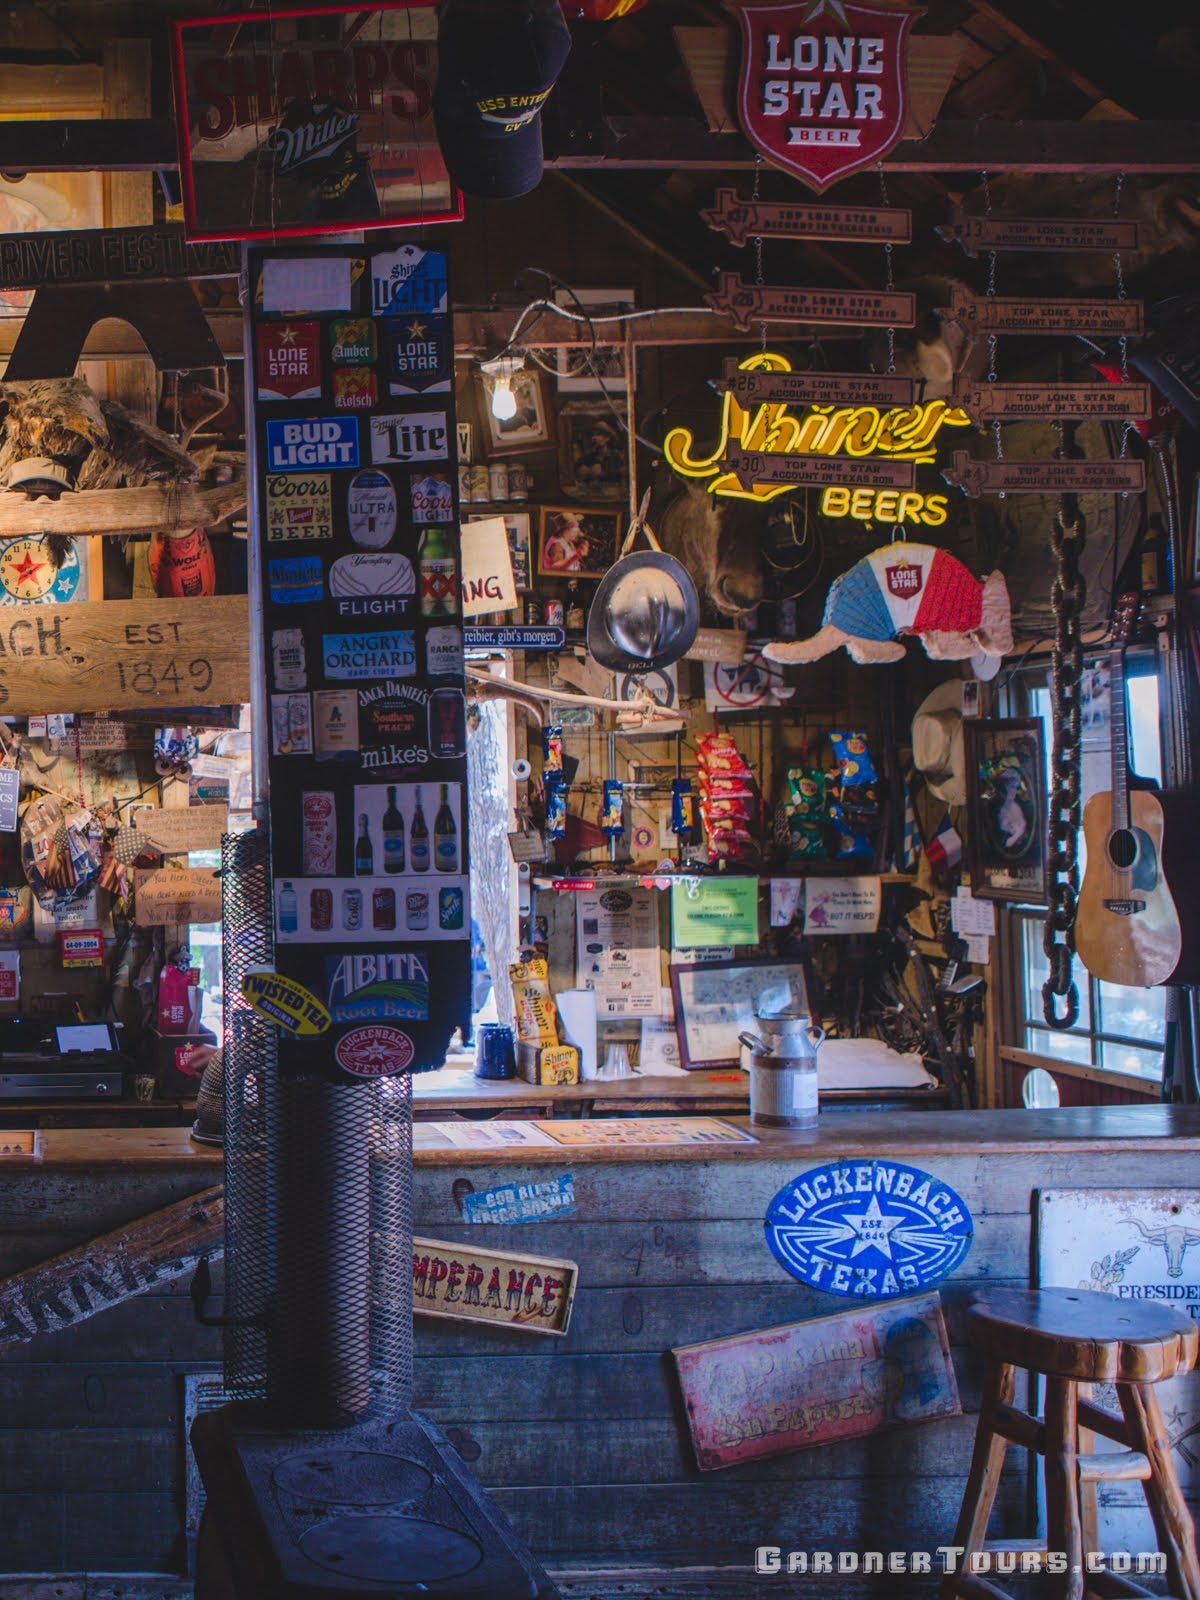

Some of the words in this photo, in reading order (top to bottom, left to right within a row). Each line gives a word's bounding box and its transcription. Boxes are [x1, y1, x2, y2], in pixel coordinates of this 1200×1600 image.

[766, 34, 884, 74] LONE
[476, 97, 506, 113] USS
[763, 80, 884, 120] STAR
[267, 111, 361, 174] Miller
[800, 130, 850, 142] BEER
[779, 211, 803, 219] TOP
[102, 232, 241, 276] FESTIVAL
[373, 278, 447, 316] LIGHT
[784, 295, 807, 304] TOP
[269, 348, 308, 362] LONE
[335, 344, 370, 358] Amber
[398, 342, 437, 355] LONE
[269, 363, 308, 376] STAR
[398, 357, 438, 371] STAR
[727, 376, 756, 392] #26
[783, 380, 807, 388] TOP
[812, 380, 841, 389] LONE
[848, 382, 879, 391] STAR
[769, 389, 818, 398] ACCOUNT
[835, 391, 869, 400] TEXAS
[963, 392, 981, 407] #3
[1017, 394, 1039, 402] TOP
[1048, 394, 1076, 402] LONE
[1084, 394, 1115, 402] STAR
[1004, 404, 1051, 412] ACCOUNT
[1069, 404, 1103, 412] TEXAS
[283, 422, 342, 445] BUD
[386, 424, 445, 460] Lite
[273, 442, 354, 466] LIGHT
[731, 456, 759, 472] #30
[785, 461, 808, 469] TOP
[814, 462, 842, 471] LONE
[851, 464, 880, 473] STAR
[1017, 467, 1040, 475] TOP
[772, 470, 820, 480] ACCOUNT
[837, 473, 870, 483] TEXAS
[964, 467, 983, 480] #4
[268, 475, 329, 497] Coors
[349, 502, 395, 514] ULTRA
[412, 493, 453, 509] Coors
[821, 487, 949, 526] BEERS
[414, 510, 449, 521] LIGHT
[271, 525, 331, 539] BEER
[172, 550, 201, 566] WOLF
[352, 555, 392, 568] Yuengling
[890, 570, 919, 581] LONE
[890, 580, 920, 591] STAR
[339, 599, 408, 615] FLIGHT
[124, 621, 183, 645] EST
[464, 629, 496, 644] reibier,
[498, 629, 522, 645] gibt's
[523, 632, 557, 645] morgen
[339, 635, 401, 652] ANGRY
[431, 645, 460, 654] RANCH
[326, 651, 415, 668] ORCHARD
[116, 657, 214, 694] 1849
[359, 684, 386, 706] JACK
[386, 680, 429, 705] DANIEL'S
[373, 711, 415, 722] Southern
[377, 723, 412, 732] PEACH
[361, 745, 428, 768] mike's
[830, 912, 843, 920] BUT
[844, 912, 851, 920] IT
[853, 912, 875, 920] HELPS!
[328, 953, 429, 1008] ABITA
[243, 975, 304, 1010] TWISTED
[304, 1004, 329, 1030] TEA
[524, 987, 549, 1030] Shiner
[260, 999, 296, 1027] ORIGINAL
[335, 1004, 377, 1021] Root
[383, 1001, 426, 1019] Beer
[341, 1028, 408, 1051] LUCKENBACH
[544, 1050, 575, 1065] Shiner
[353, 1061, 395, 1073] TEXAS
[486, 1189, 515, 1208] GOD
[778, 1166, 964, 1232] LUCKENBACH
[859, 1232, 885, 1241] 1849
[810, 1254, 919, 1295] TEXAS
[1117, 1285, 1200, 1300] PRESIDE
